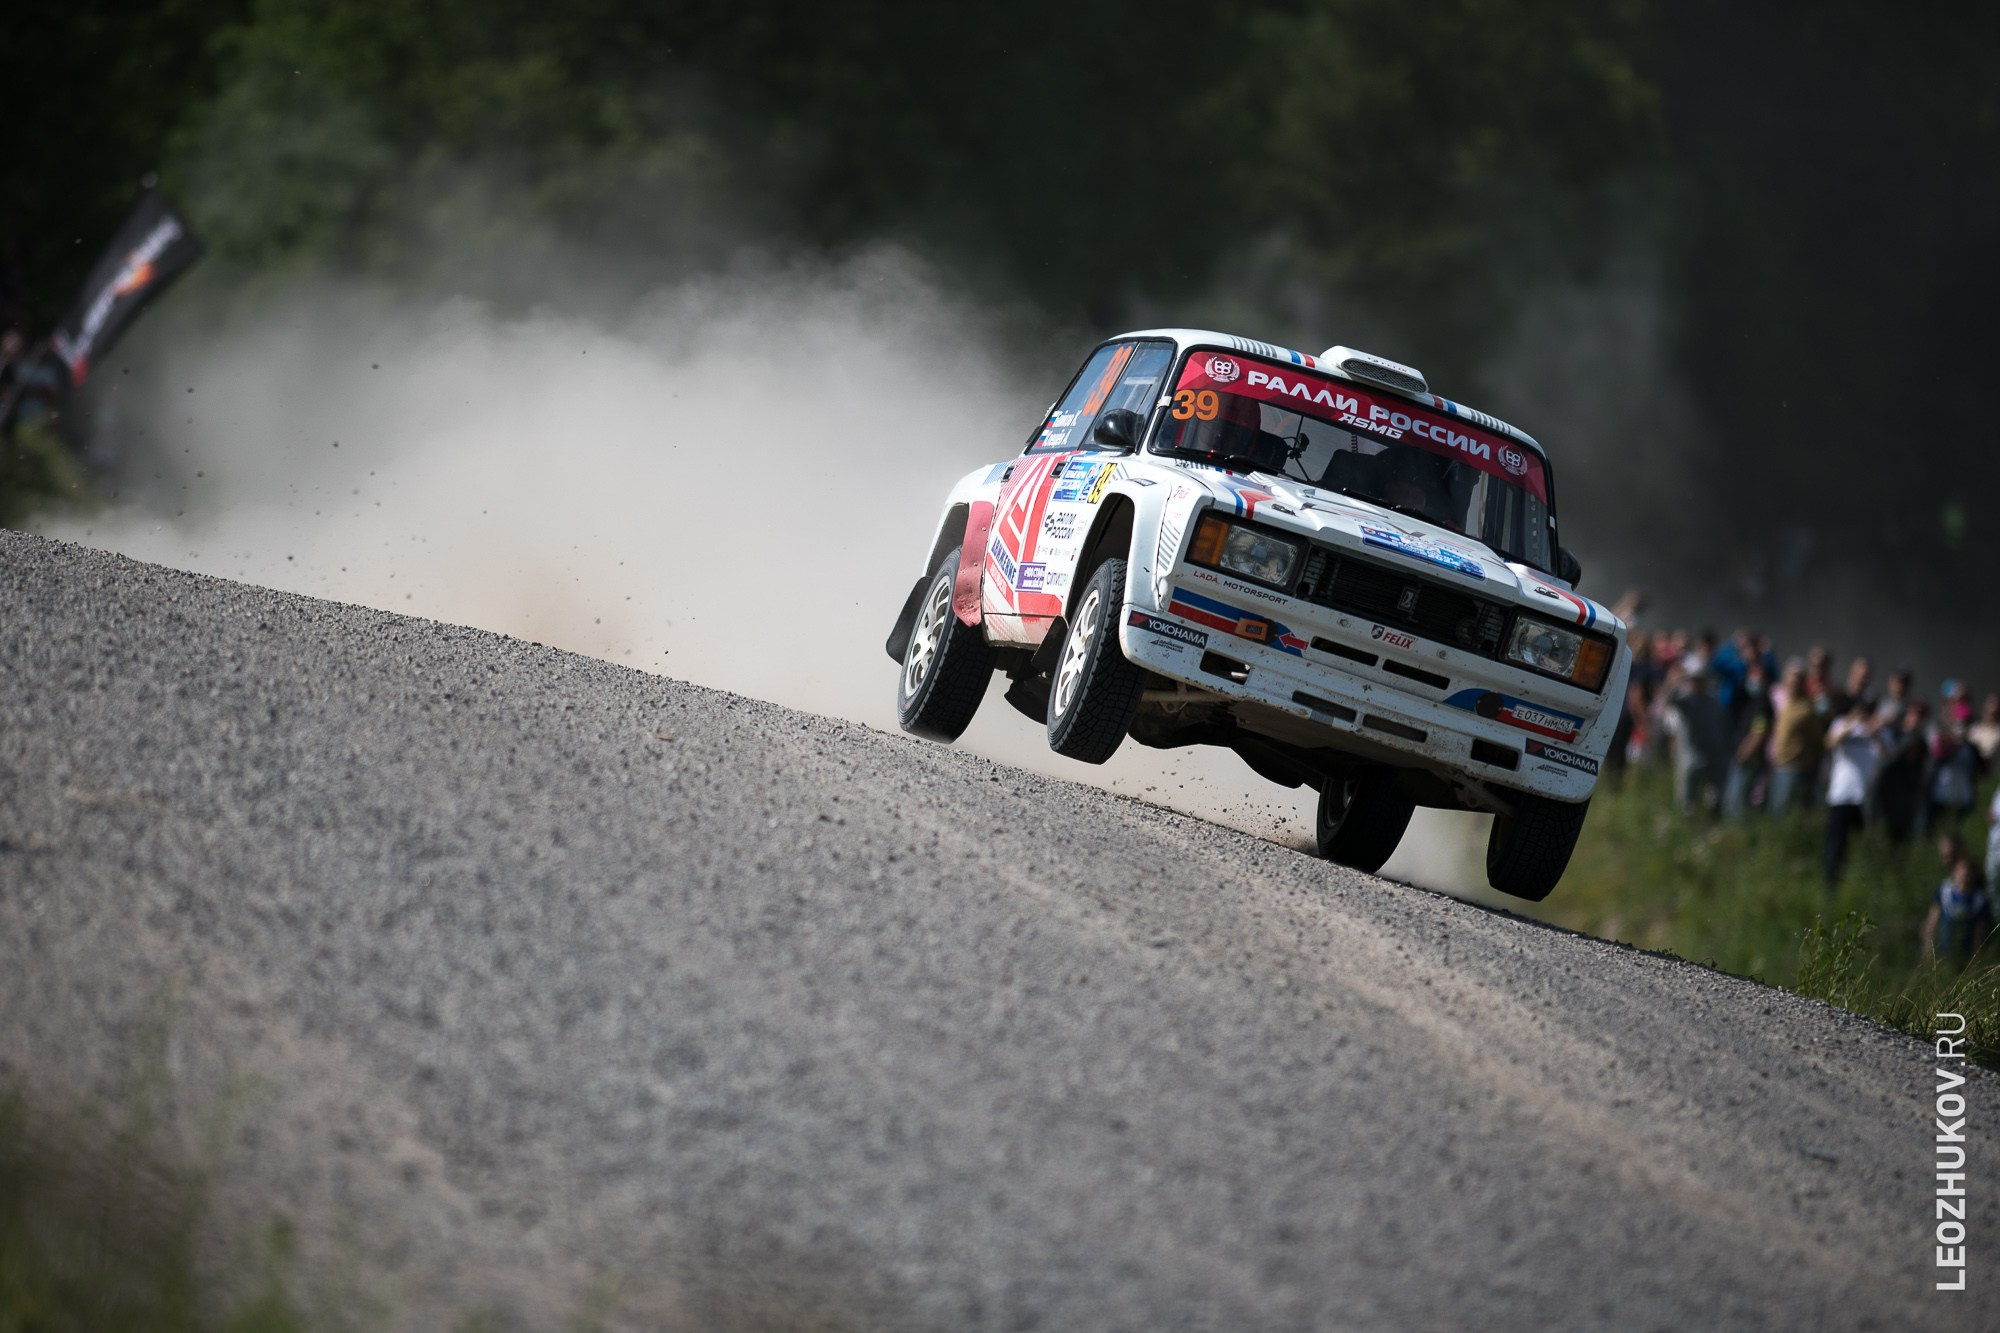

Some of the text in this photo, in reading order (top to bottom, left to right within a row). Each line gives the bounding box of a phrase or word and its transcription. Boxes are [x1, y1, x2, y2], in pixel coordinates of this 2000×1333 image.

[1171, 389, 1220, 422] 39
[1247, 370, 1491, 461] РАЛЛИ РОССИИ
[1193, 570, 1289, 606] LADA MOTORSPORT
[1148, 619, 1207, 647] YOKOHAMA
[1382, 631, 1414, 650] FELIX
[1543, 746, 1597, 773] YOKOHAMA
